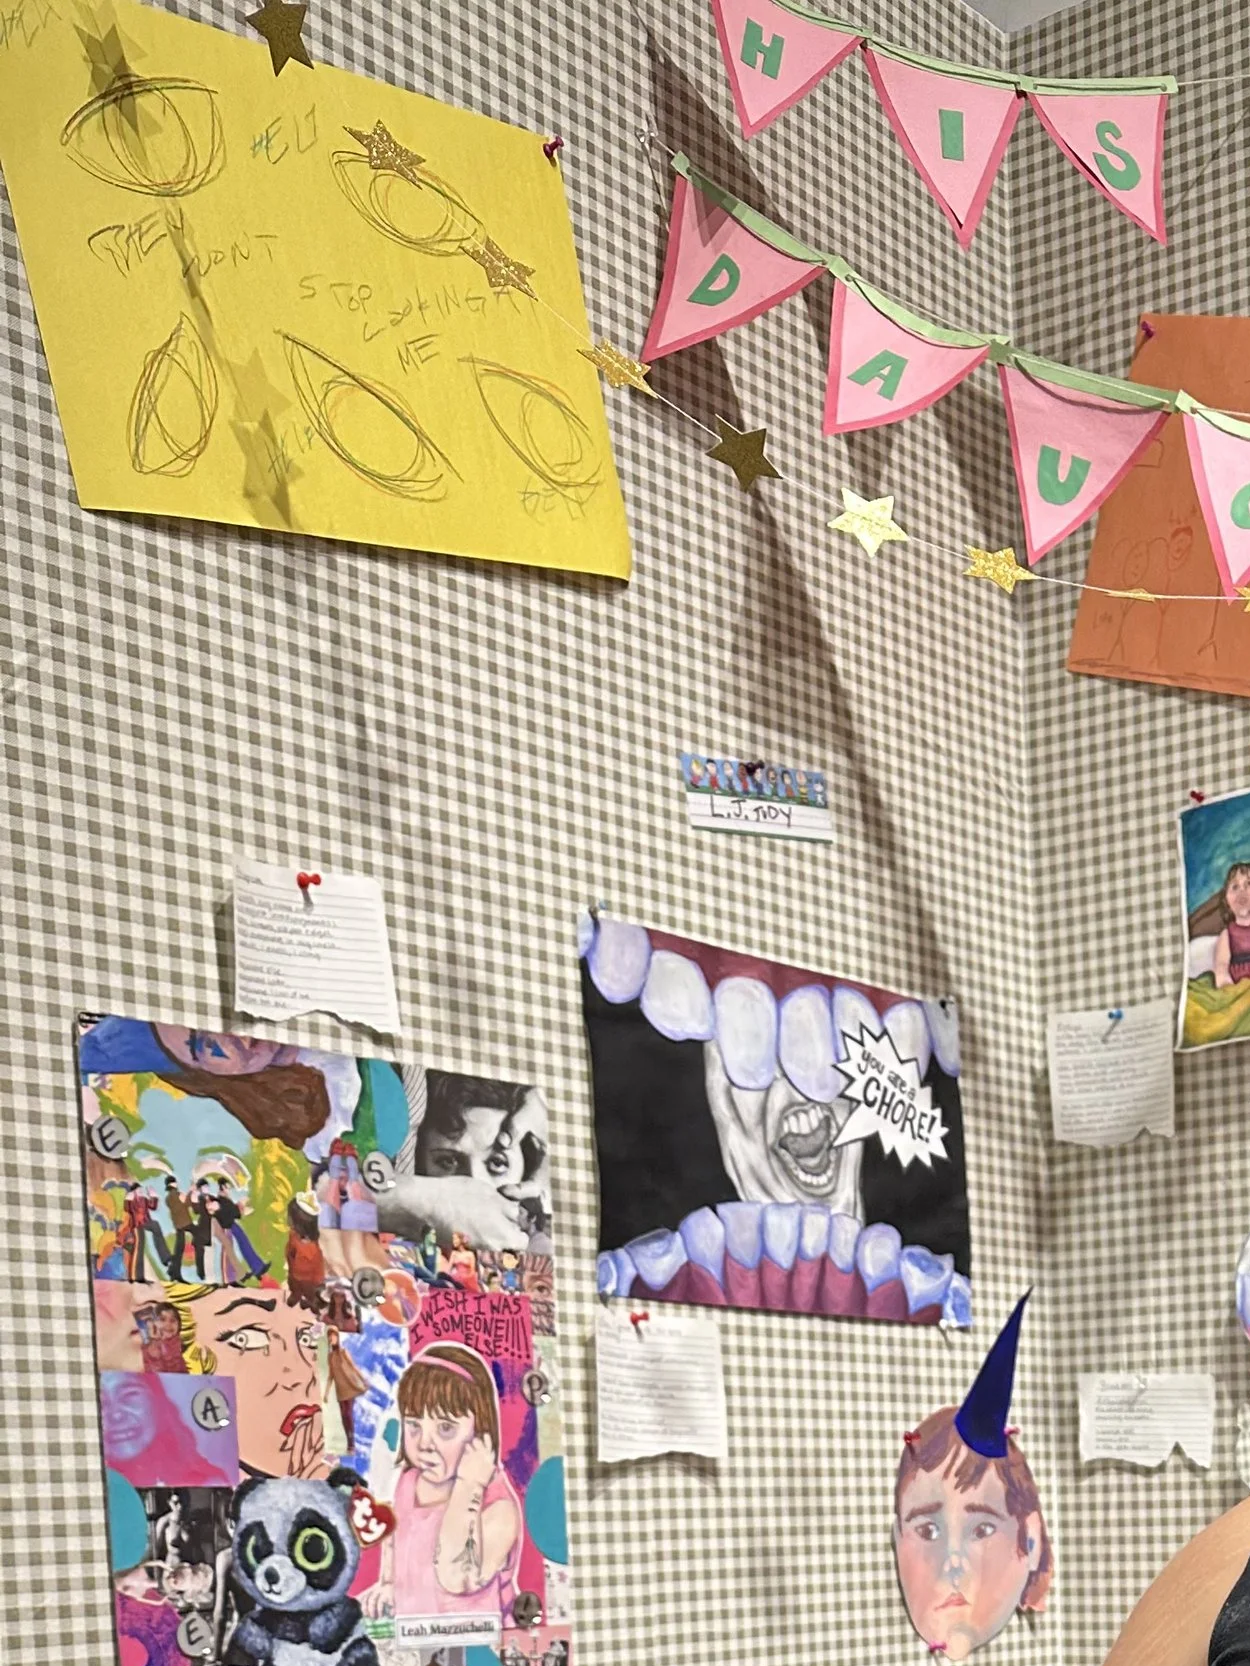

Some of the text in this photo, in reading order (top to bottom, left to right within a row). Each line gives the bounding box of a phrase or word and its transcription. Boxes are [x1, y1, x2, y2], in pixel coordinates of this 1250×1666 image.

[87, 206, 185, 278] THEY
[299, 273, 374, 312] STOP
[397, 333, 440, 374] ME
[857, 1049, 917, 1102] you are a
[862, 1076, 937, 1143] CHORE!
[97, 1117, 122, 1153] E
[366, 1159, 385, 1184] S
[357, 1276, 376, 1300] C
[420, 1289, 468, 1328] WISH
[473, 1294, 487, 1316] I
[489, 1297, 522, 1316] WAS
[202, 1395, 220, 1423] A
[352, 1496, 387, 1543] ty
[185, 1617, 205, 1647] E
[401, 1623, 428, 1637] Leah
